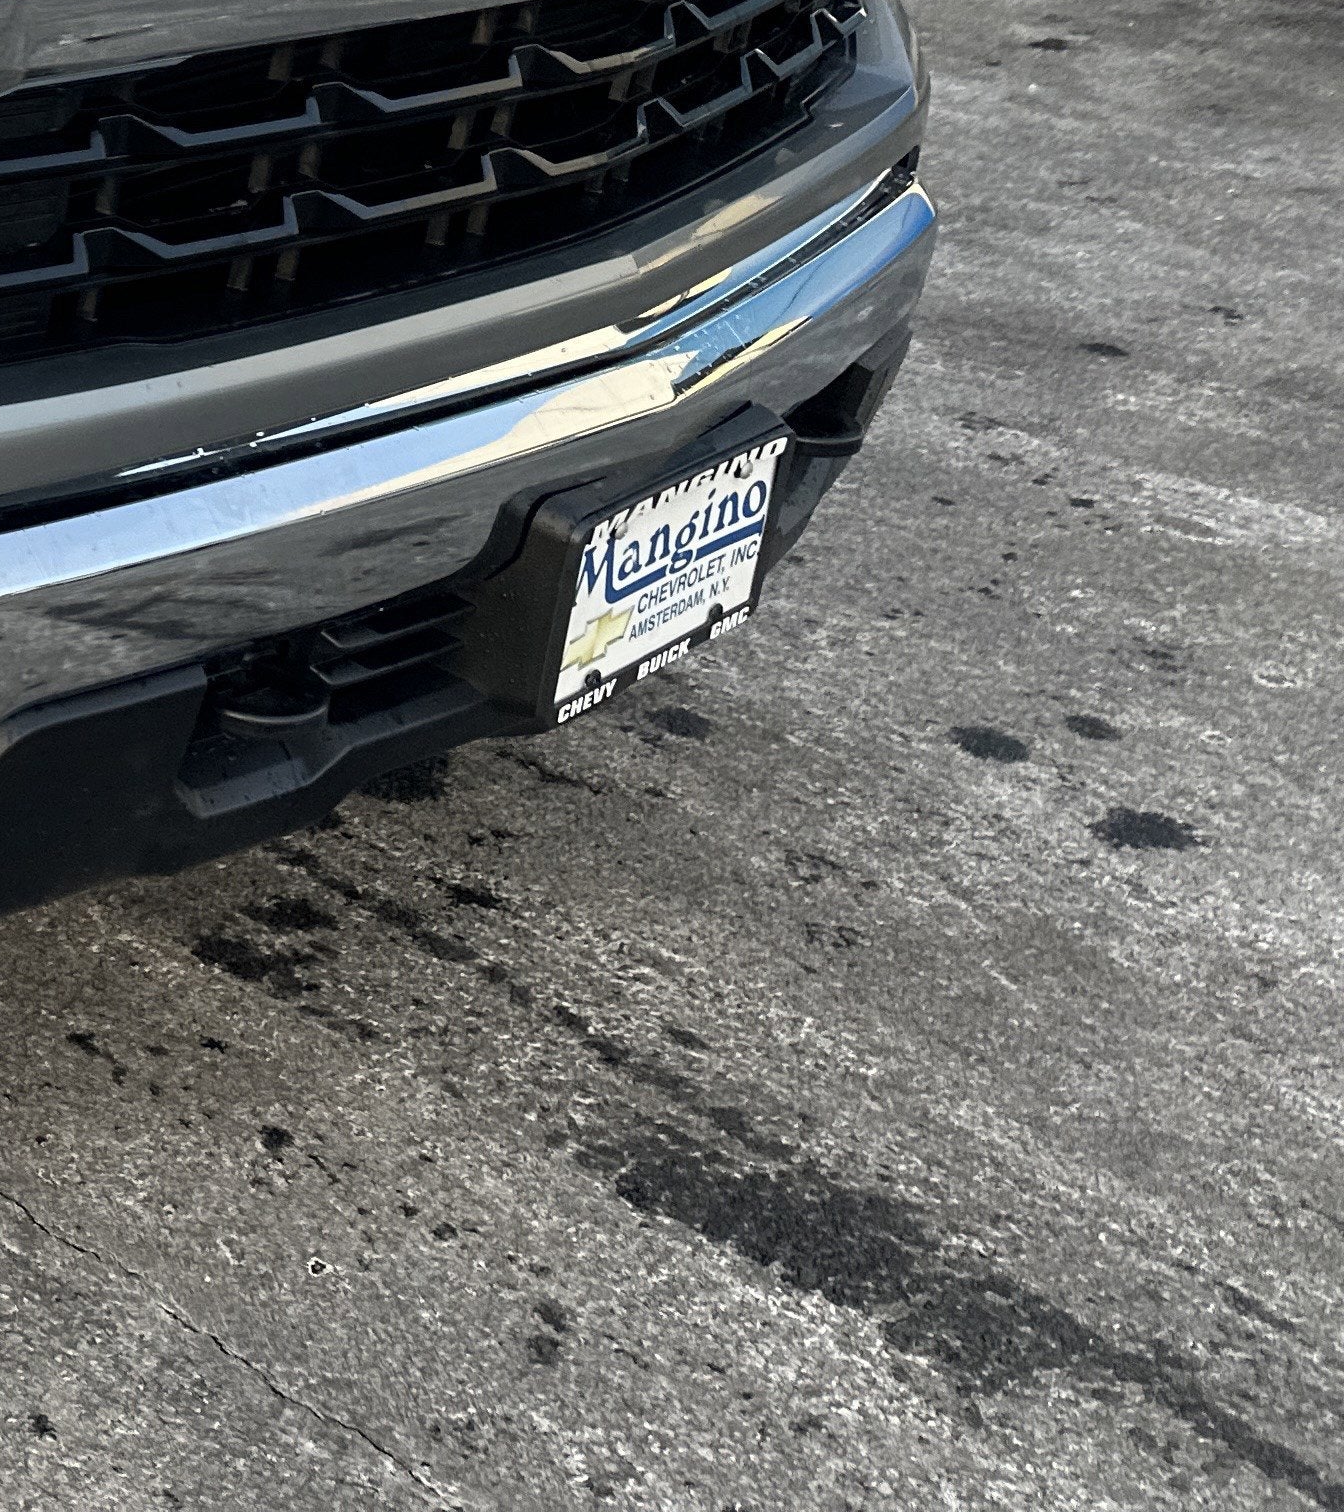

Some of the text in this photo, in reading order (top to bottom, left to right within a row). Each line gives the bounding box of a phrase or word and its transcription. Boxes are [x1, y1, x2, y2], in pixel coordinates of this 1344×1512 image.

[577, 480, 767, 602] Mangino
[590, 436, 789, 546] MANGINO
[628, 575, 731, 642] AMSTERDAM, N.Y.
[637, 553, 726, 614] CHEVROLET,
[556, 606, 751, 725] CHEVY BUICK GMC
